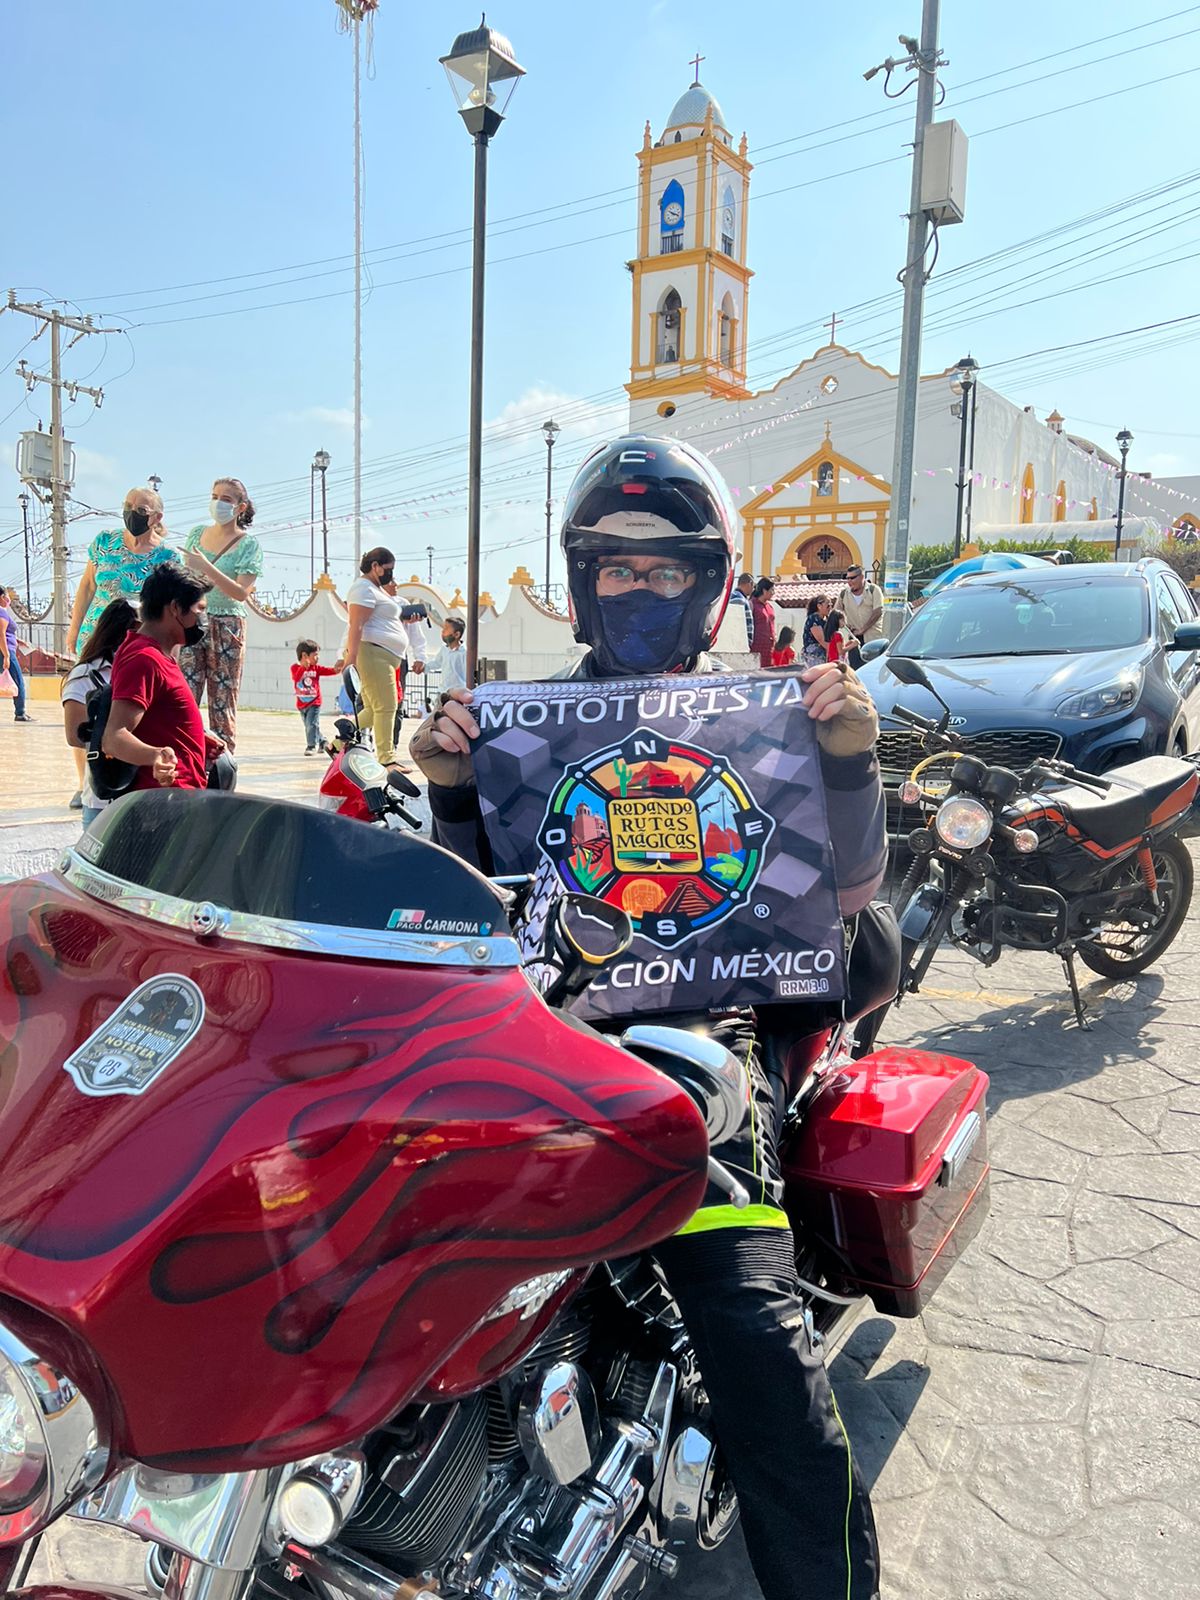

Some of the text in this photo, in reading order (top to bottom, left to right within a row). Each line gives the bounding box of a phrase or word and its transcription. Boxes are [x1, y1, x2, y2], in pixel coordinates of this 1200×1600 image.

[479, 677, 803, 730] MOTOTURISTA
[634, 739, 657, 756] N
[744, 819, 764, 837] E
[545, 828, 567, 847] O
[395, 918, 479, 934] PACO CARMONA
[656, 918, 678, 936] S
[711, 947, 836, 980] MÉXICO
